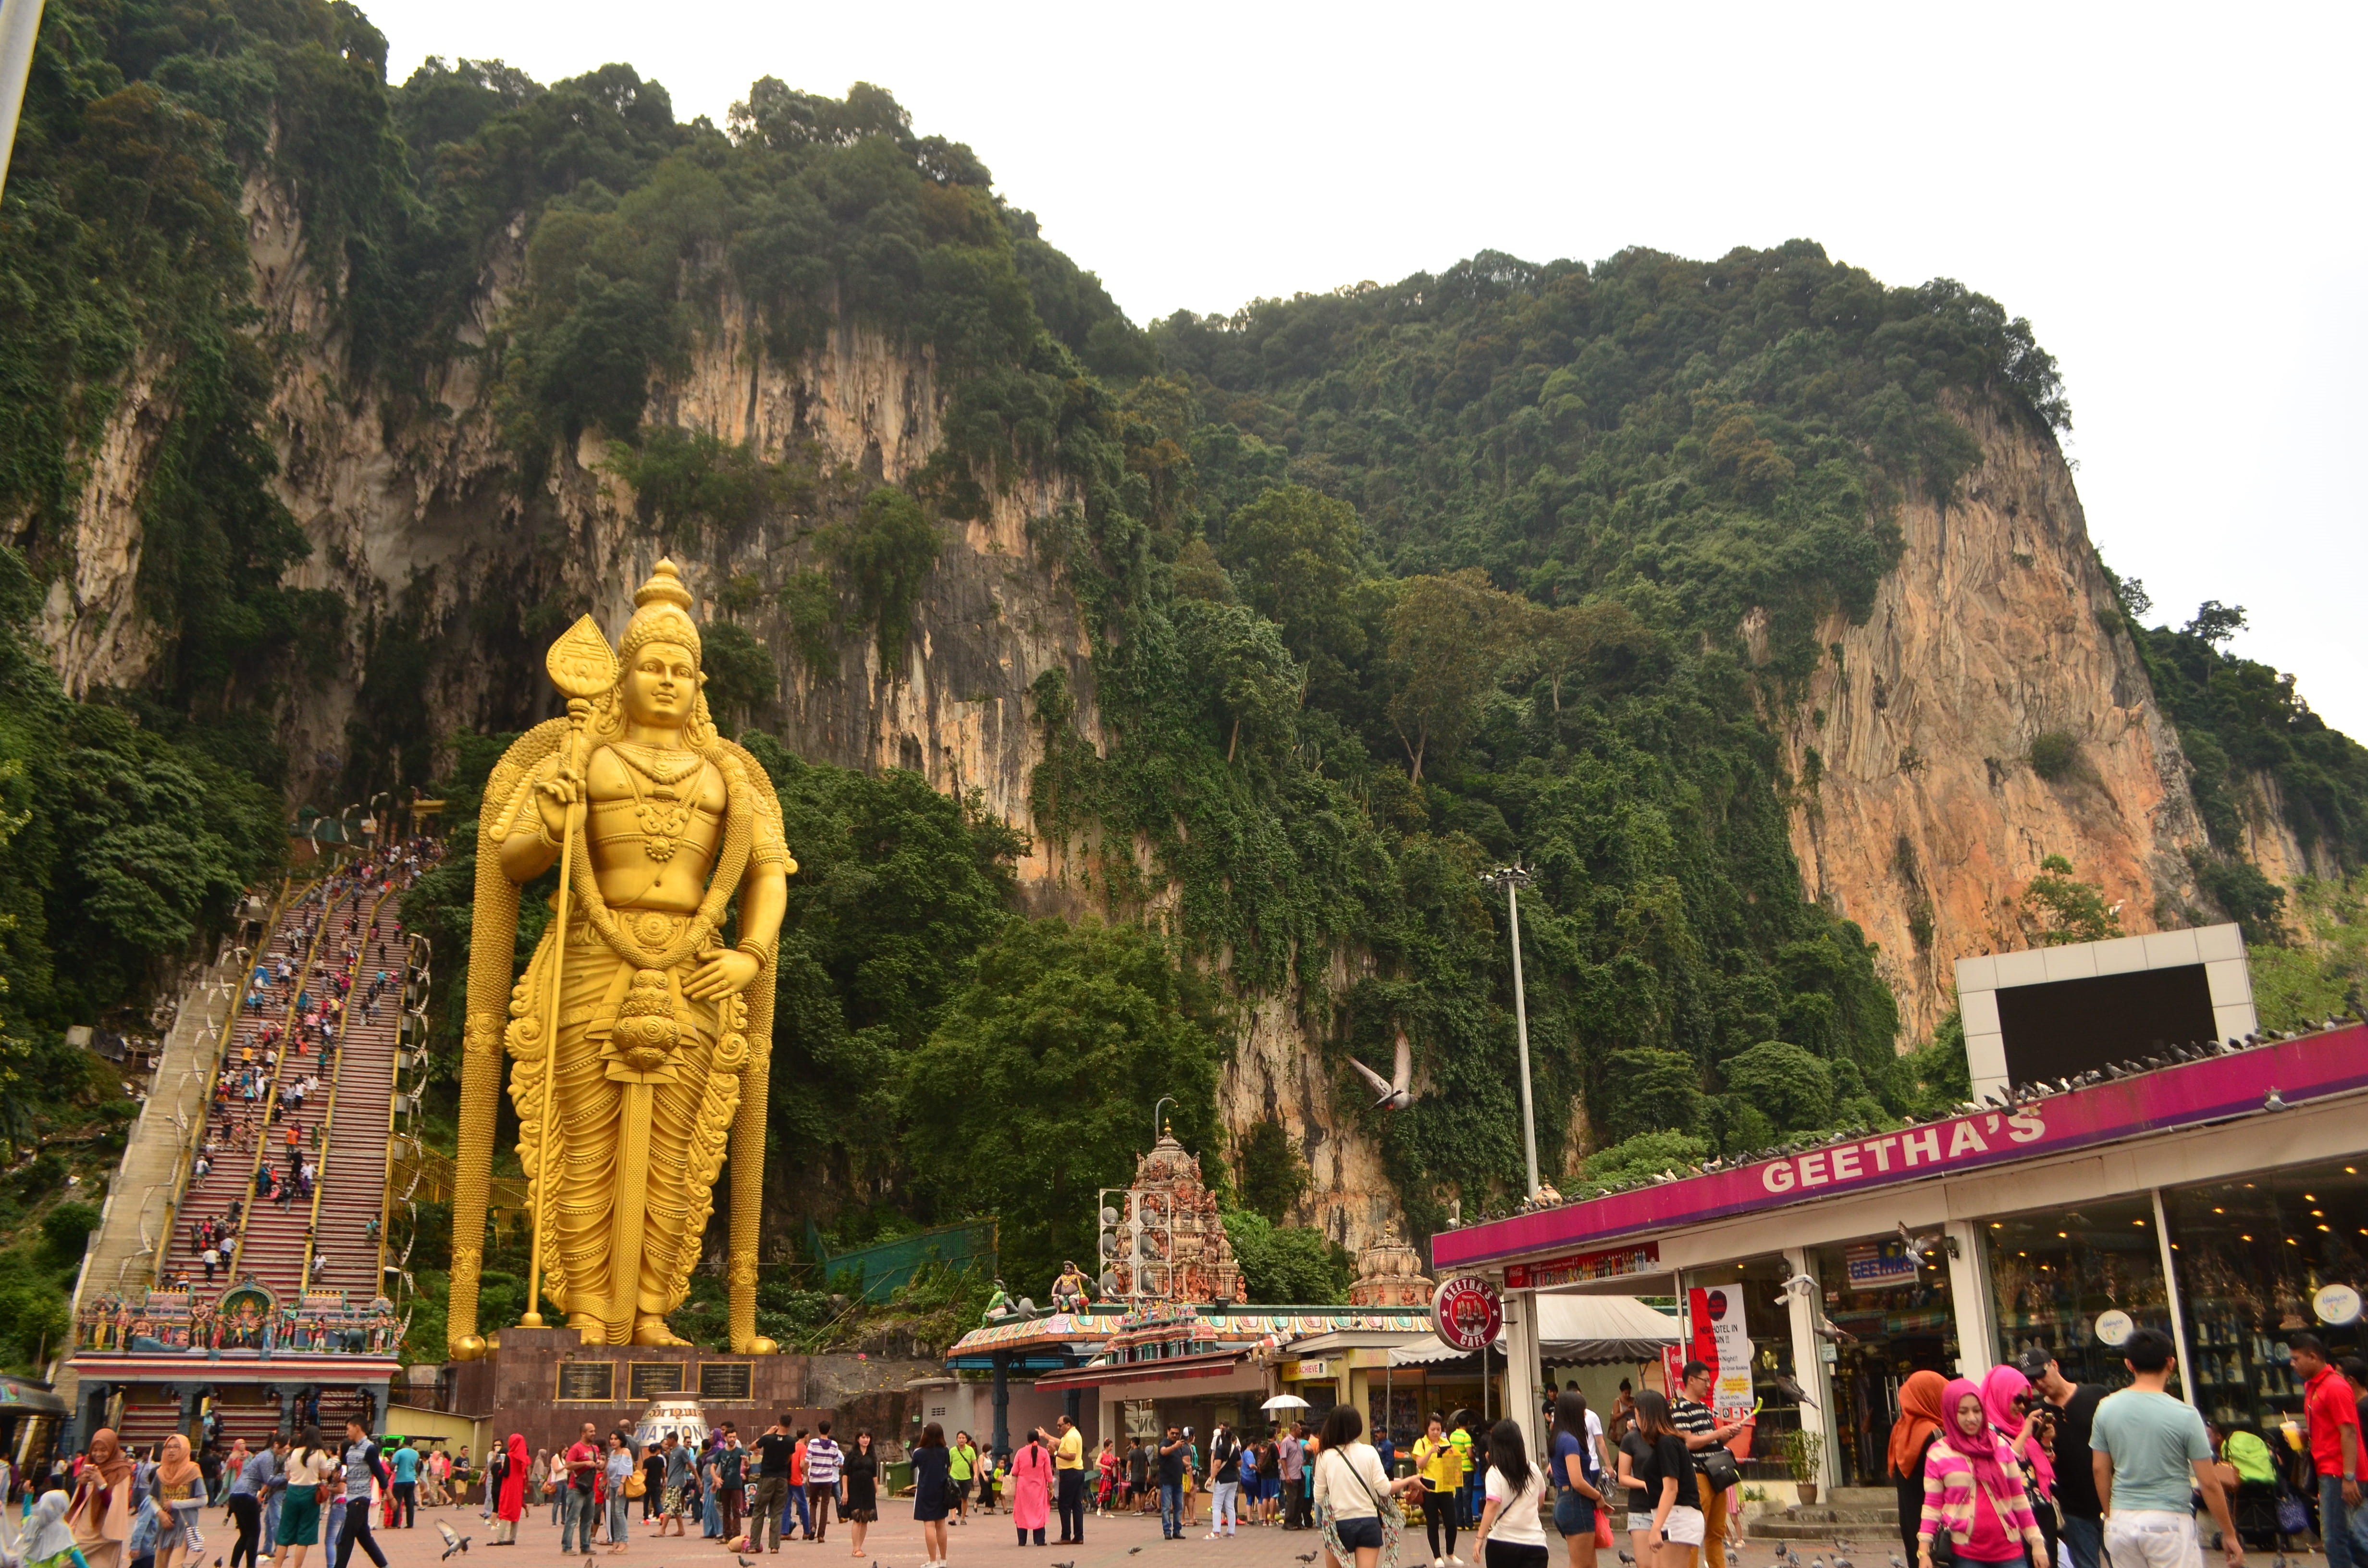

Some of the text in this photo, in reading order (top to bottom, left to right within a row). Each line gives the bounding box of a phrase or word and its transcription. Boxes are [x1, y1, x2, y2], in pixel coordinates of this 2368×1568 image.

[1762, 1107, 2046, 1193] GEETHA'S
[1444, 1278, 1493, 1301] GEETHA'S
[1713, 1325, 1730, 1334] HOTEL
[1731, 1324, 1738, 1332] IN
[1460, 1334, 1486, 1347] CAFE
[1709, 1335, 1724, 1344] TOWN
[1288, 1364, 1318, 1375] BRC ACHIEVE
